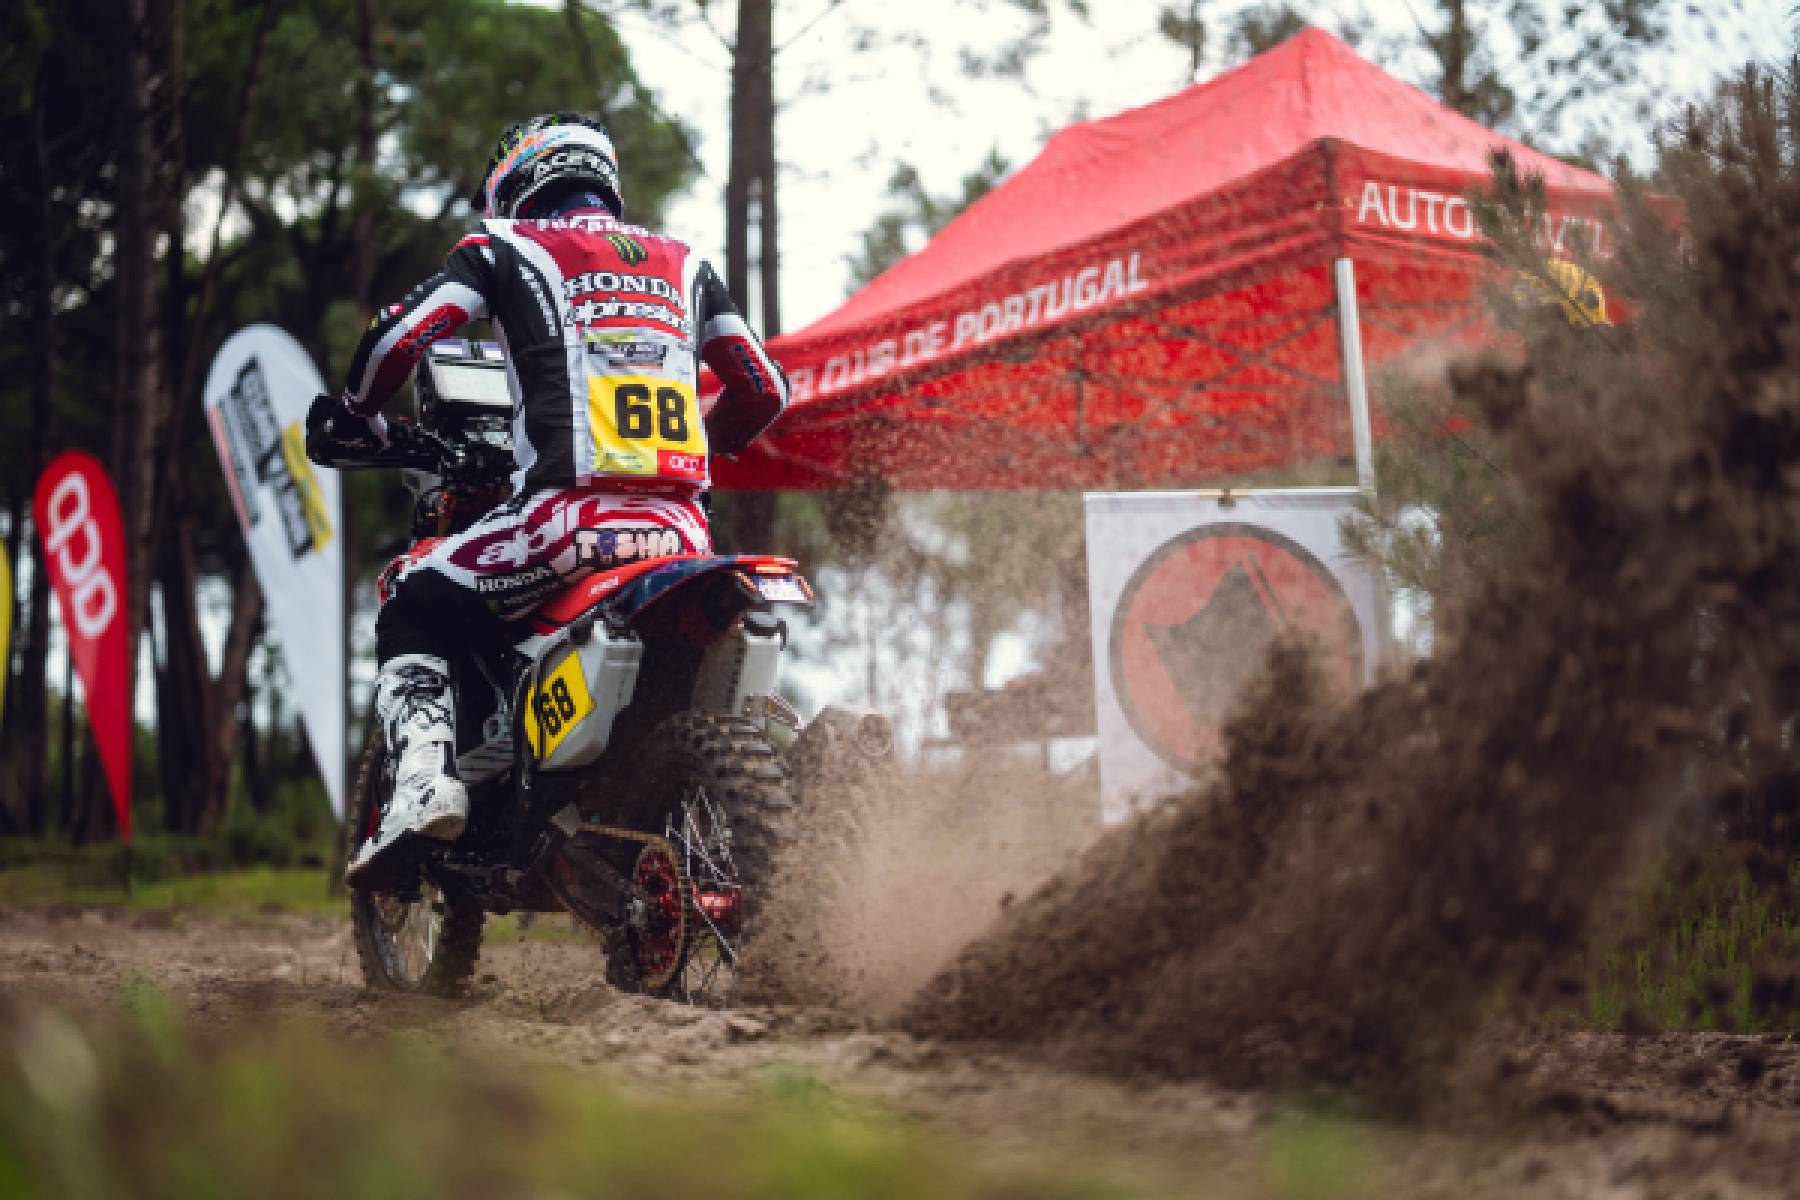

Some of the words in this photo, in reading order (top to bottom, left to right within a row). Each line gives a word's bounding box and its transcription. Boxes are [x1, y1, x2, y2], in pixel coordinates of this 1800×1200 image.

[819, 338, 897, 394] CLUB
[900, 321, 947, 366] DE
[951, 252, 1149, 349] PORTUGAL
[615, 384, 688, 442] 68
[532, 676, 576, 738] 68
